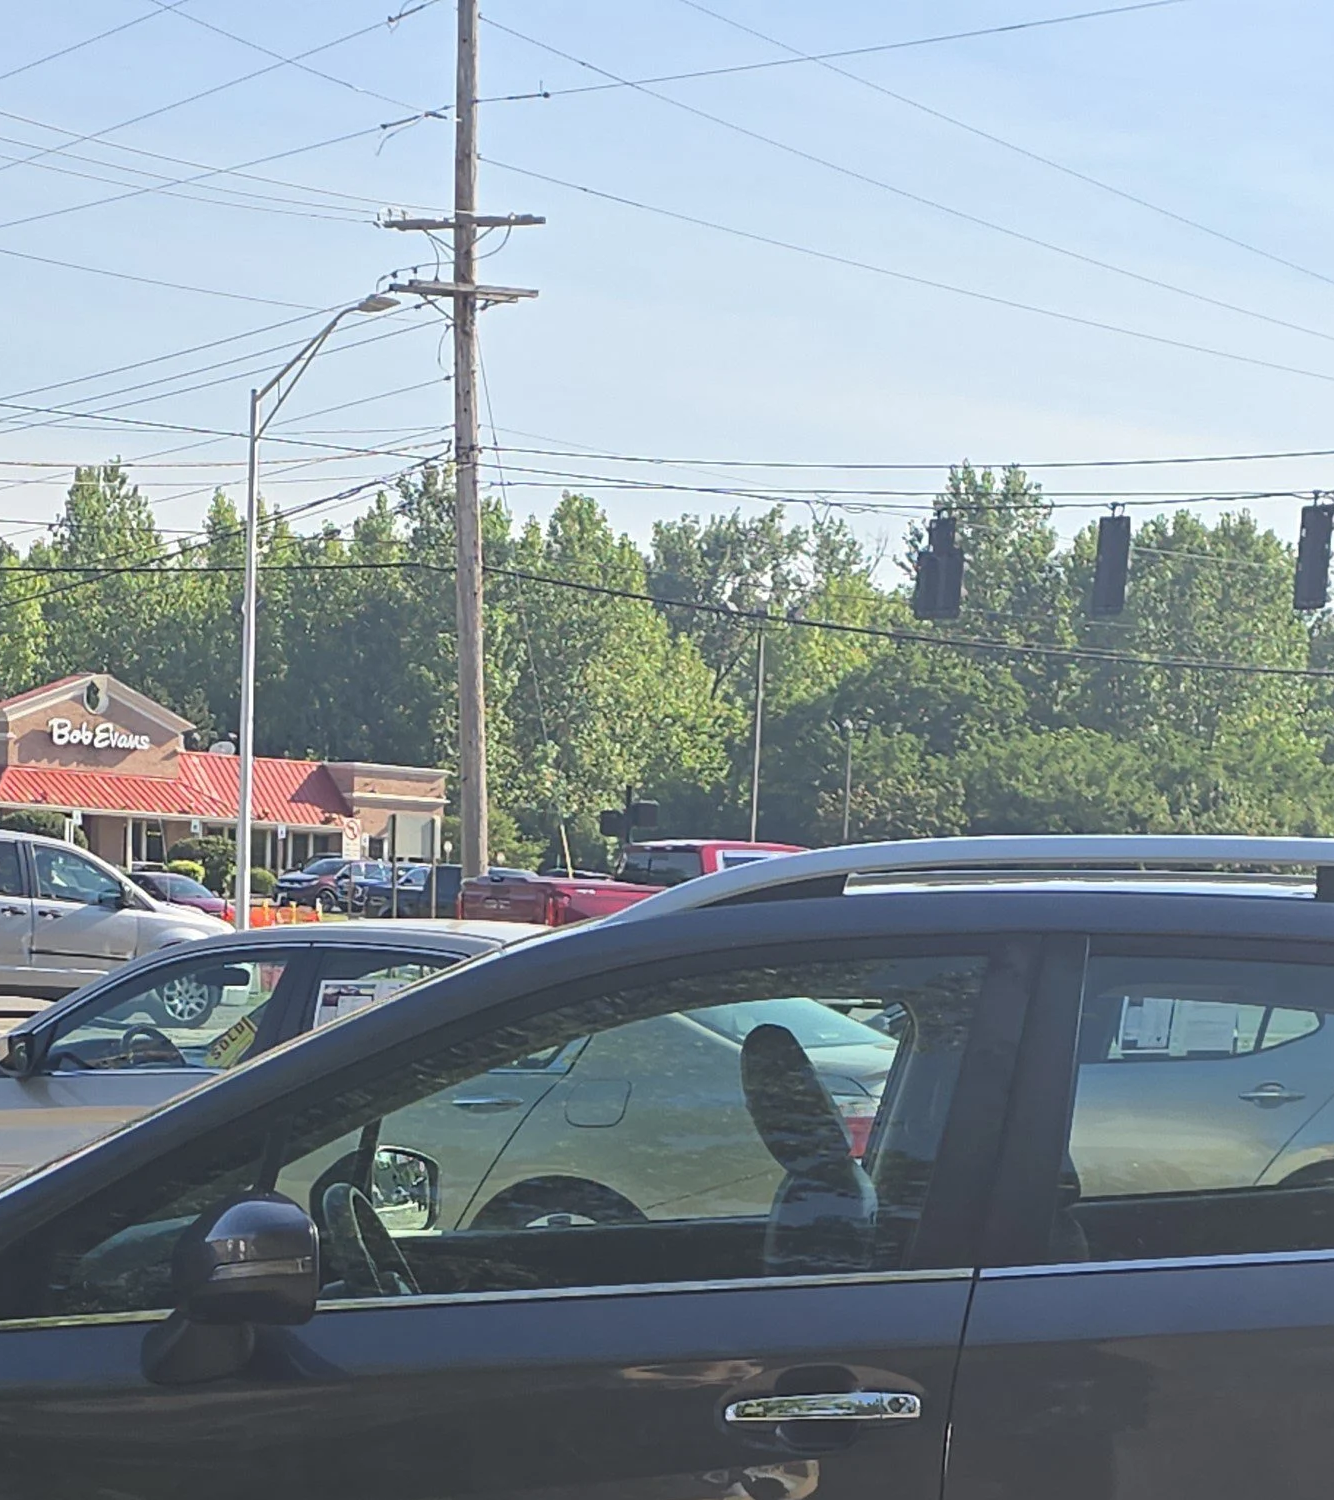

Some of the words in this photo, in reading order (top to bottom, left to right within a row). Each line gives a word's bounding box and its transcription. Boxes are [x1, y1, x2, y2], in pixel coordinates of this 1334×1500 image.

[48, 717, 94, 746] Bob
[93, 722, 151, 750] Evans
[210, 1021, 246, 1060] SOLD
